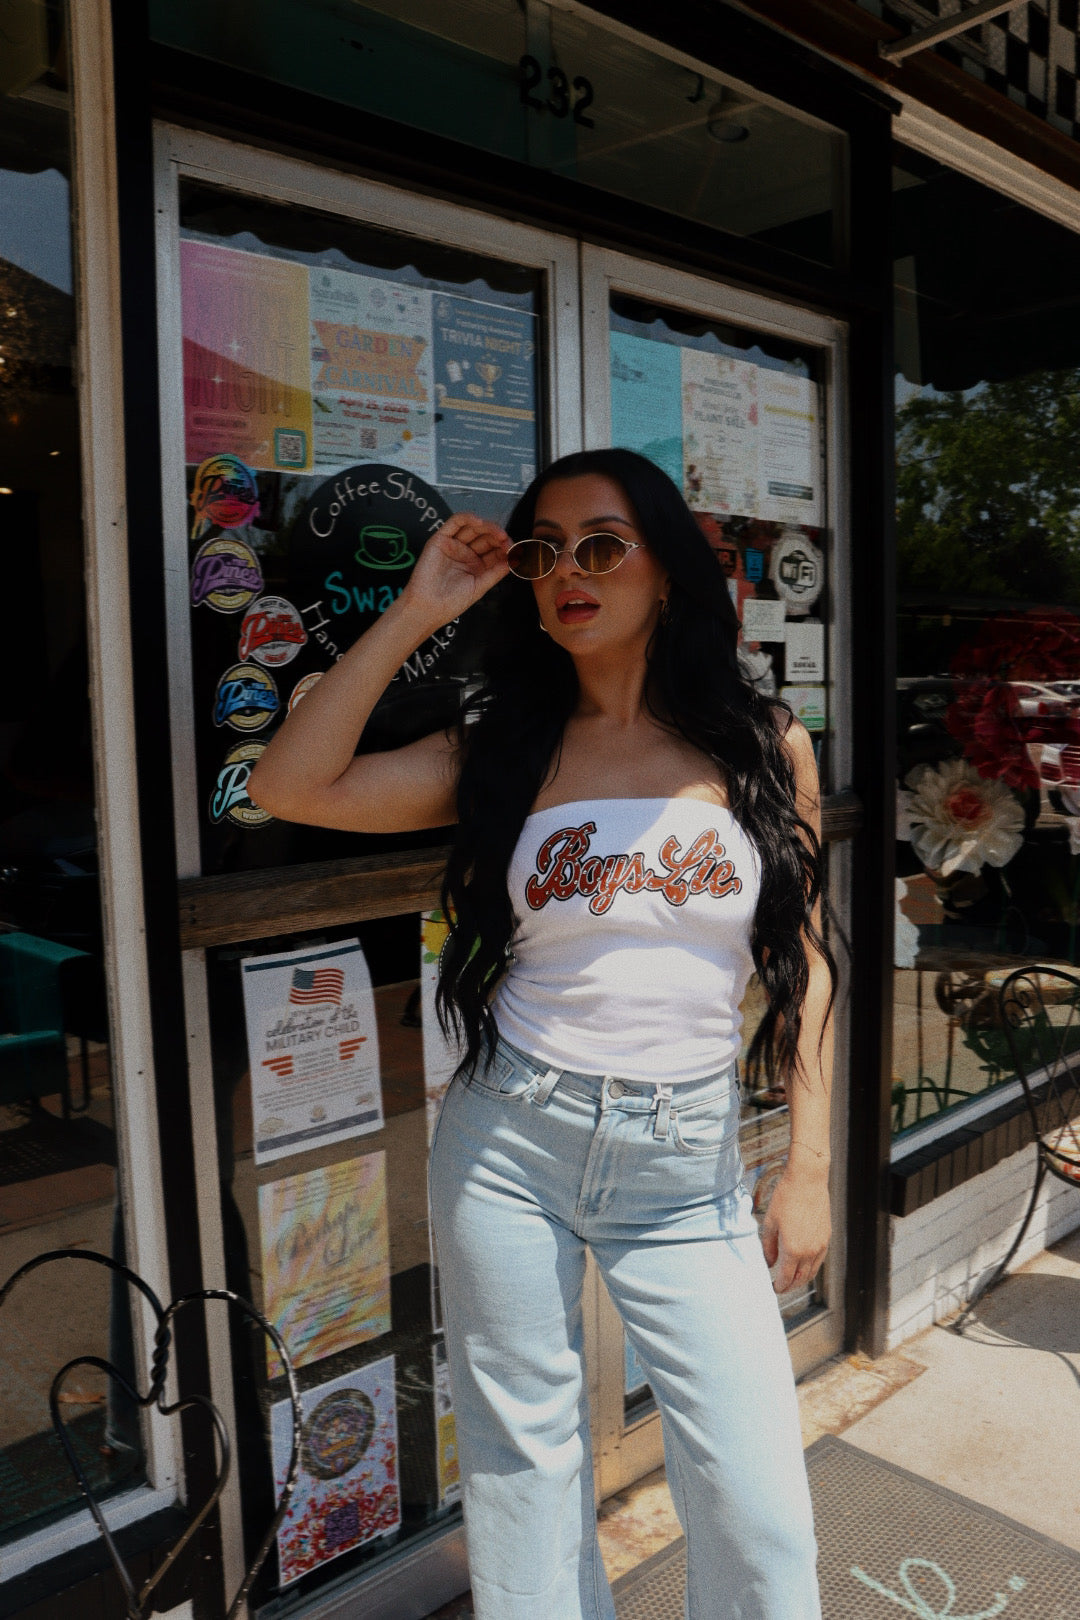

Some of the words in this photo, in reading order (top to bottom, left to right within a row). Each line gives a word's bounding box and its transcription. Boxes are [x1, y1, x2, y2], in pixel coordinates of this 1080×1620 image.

[518, 54, 595, 129] 232
[335, 330, 413, 358] GARDEN
[439, 327, 483, 348] TRIVIA
[484, 336, 522, 356] NIGHT
[324, 365, 420, 397] CARNIVAL
[308, 475, 382, 538] Coffee
[192, 555, 263, 602] Pines
[324, 569, 404, 615] Swa
[239, 611, 307, 660] Pines
[215, 679, 280, 725] Pines
[526, 820, 651, 915] Boys
[649, 828, 742, 907] Lie
[265, 1029, 322, 1052] MILITARY
[324, 1020, 361, 1039] CHILD
